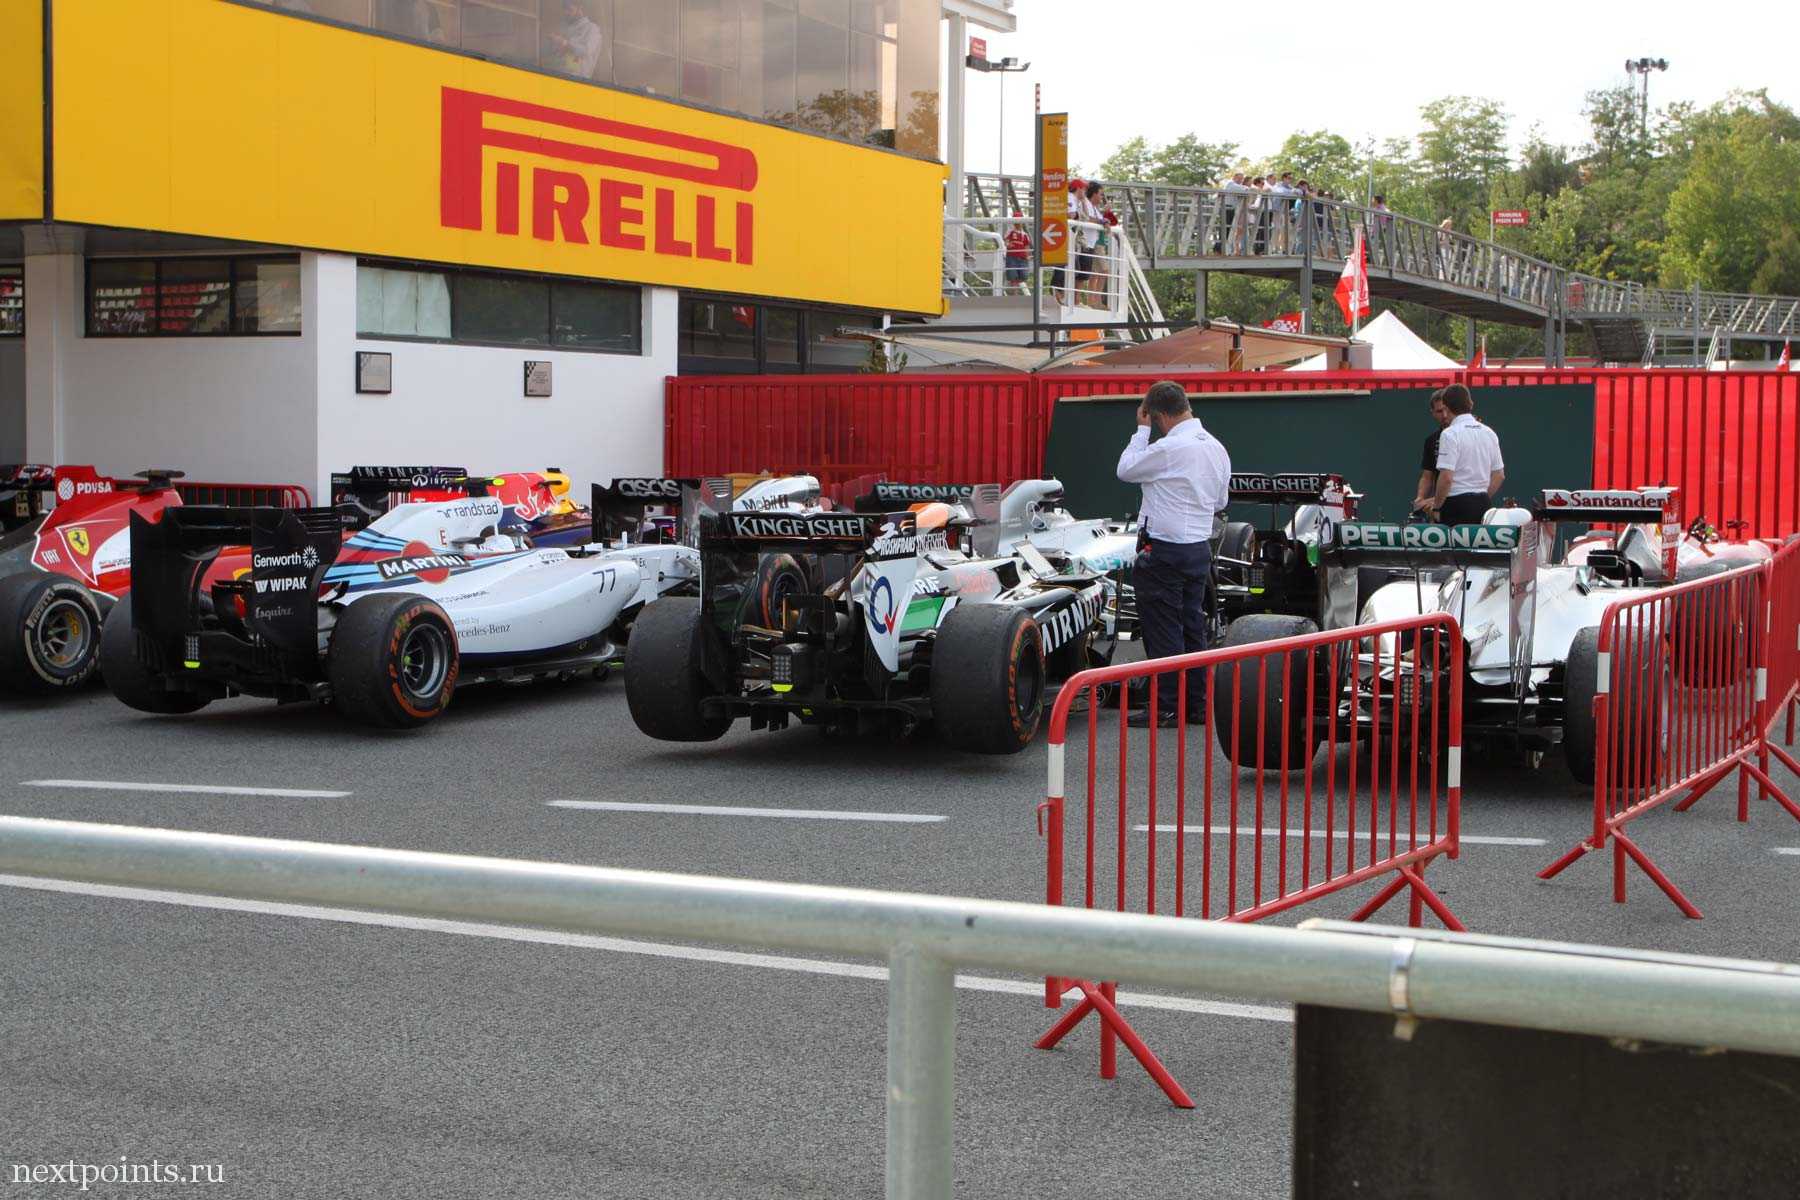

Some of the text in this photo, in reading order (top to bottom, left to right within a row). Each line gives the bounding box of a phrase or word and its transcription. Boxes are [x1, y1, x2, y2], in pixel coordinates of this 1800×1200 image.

[441, 86, 758, 265] PIRELLI
[76, 481, 112, 495] PDVSA
[618, 479, 681, 497] asos
[1229, 476, 1320, 491] INGFISHER
[876, 485, 972, 499] PETRONAS
[1570, 491, 1666, 508] Santander
[455, 502, 499, 518] randstad
[1341, 524, 1516, 548] PETRONAS
[253, 552, 302, 568] Genworth
[382, 554, 465, 577] MARTINI
[270, 576, 307, 592] WIPAK
[592, 568, 616, 594] 77
[457, 623, 512, 639] rcedes-Benz
